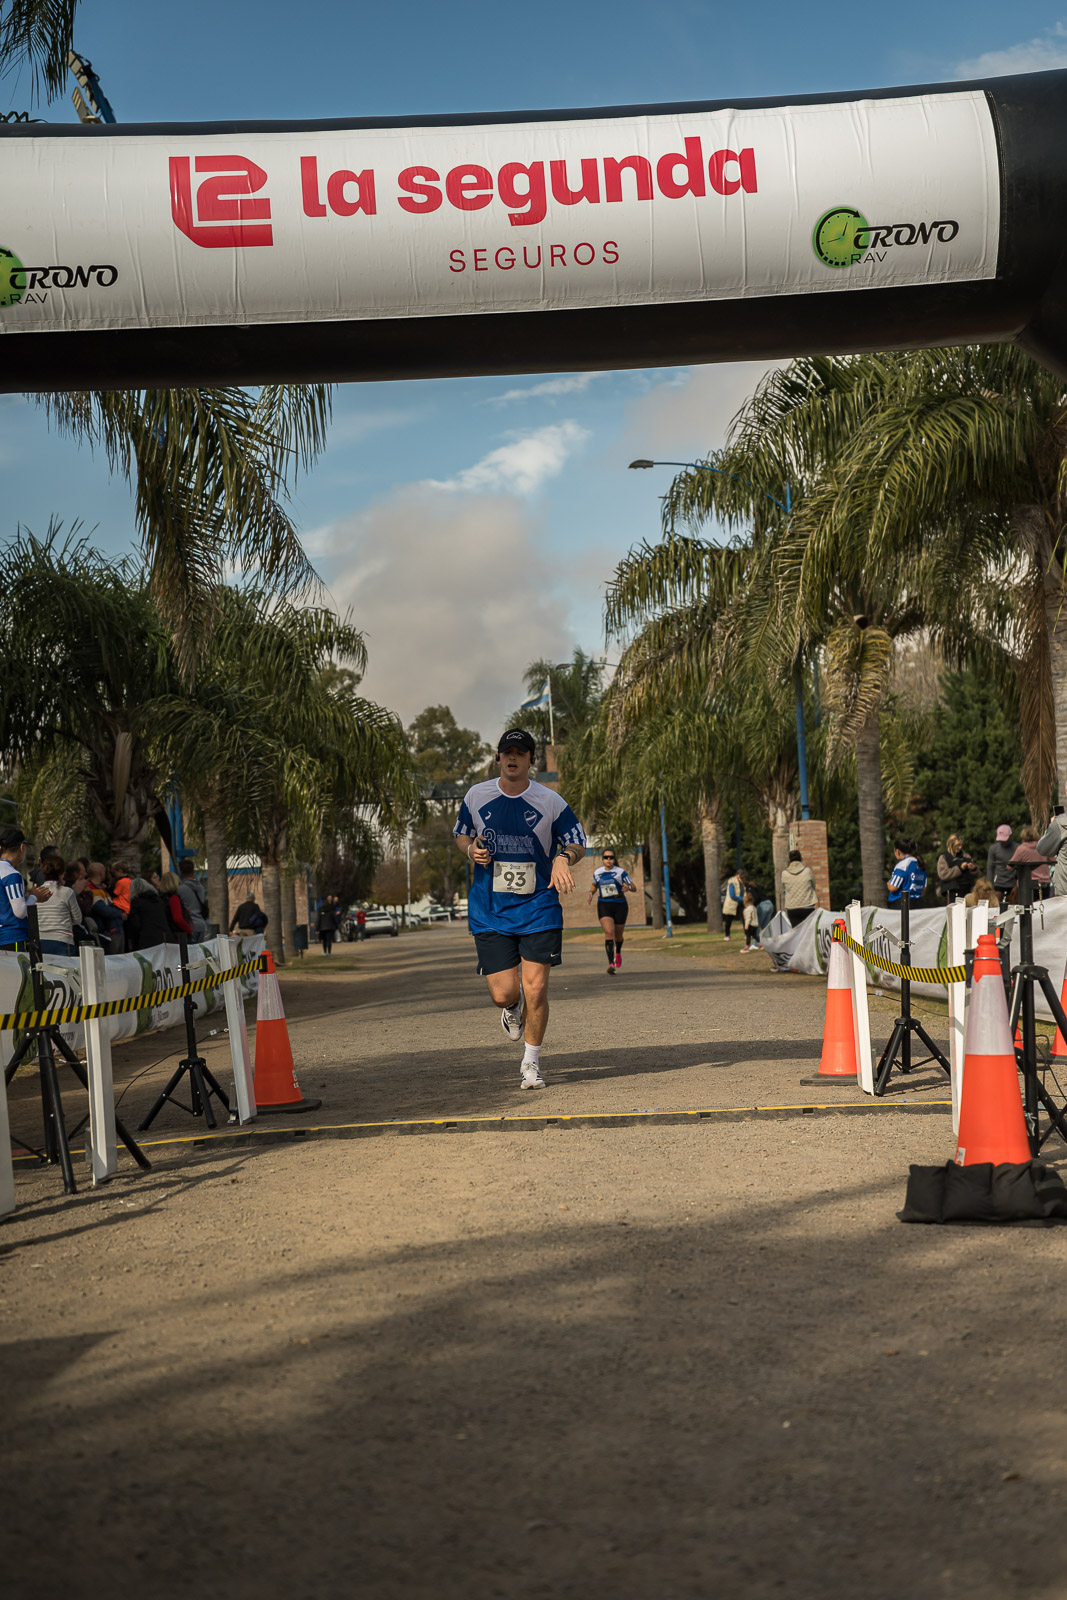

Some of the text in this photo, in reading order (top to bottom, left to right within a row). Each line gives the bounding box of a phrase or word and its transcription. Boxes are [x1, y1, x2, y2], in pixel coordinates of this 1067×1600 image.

[300, 136, 758, 227] la segunda
[853, 220, 959, 249] CRONO
[449, 241, 620, 273] SEGUROS
[850, 251, 888, 265] RAV
[9, 265, 118, 289] CRONO
[9, 293, 48, 304] RAV
[503, 871, 527, 887] 93
